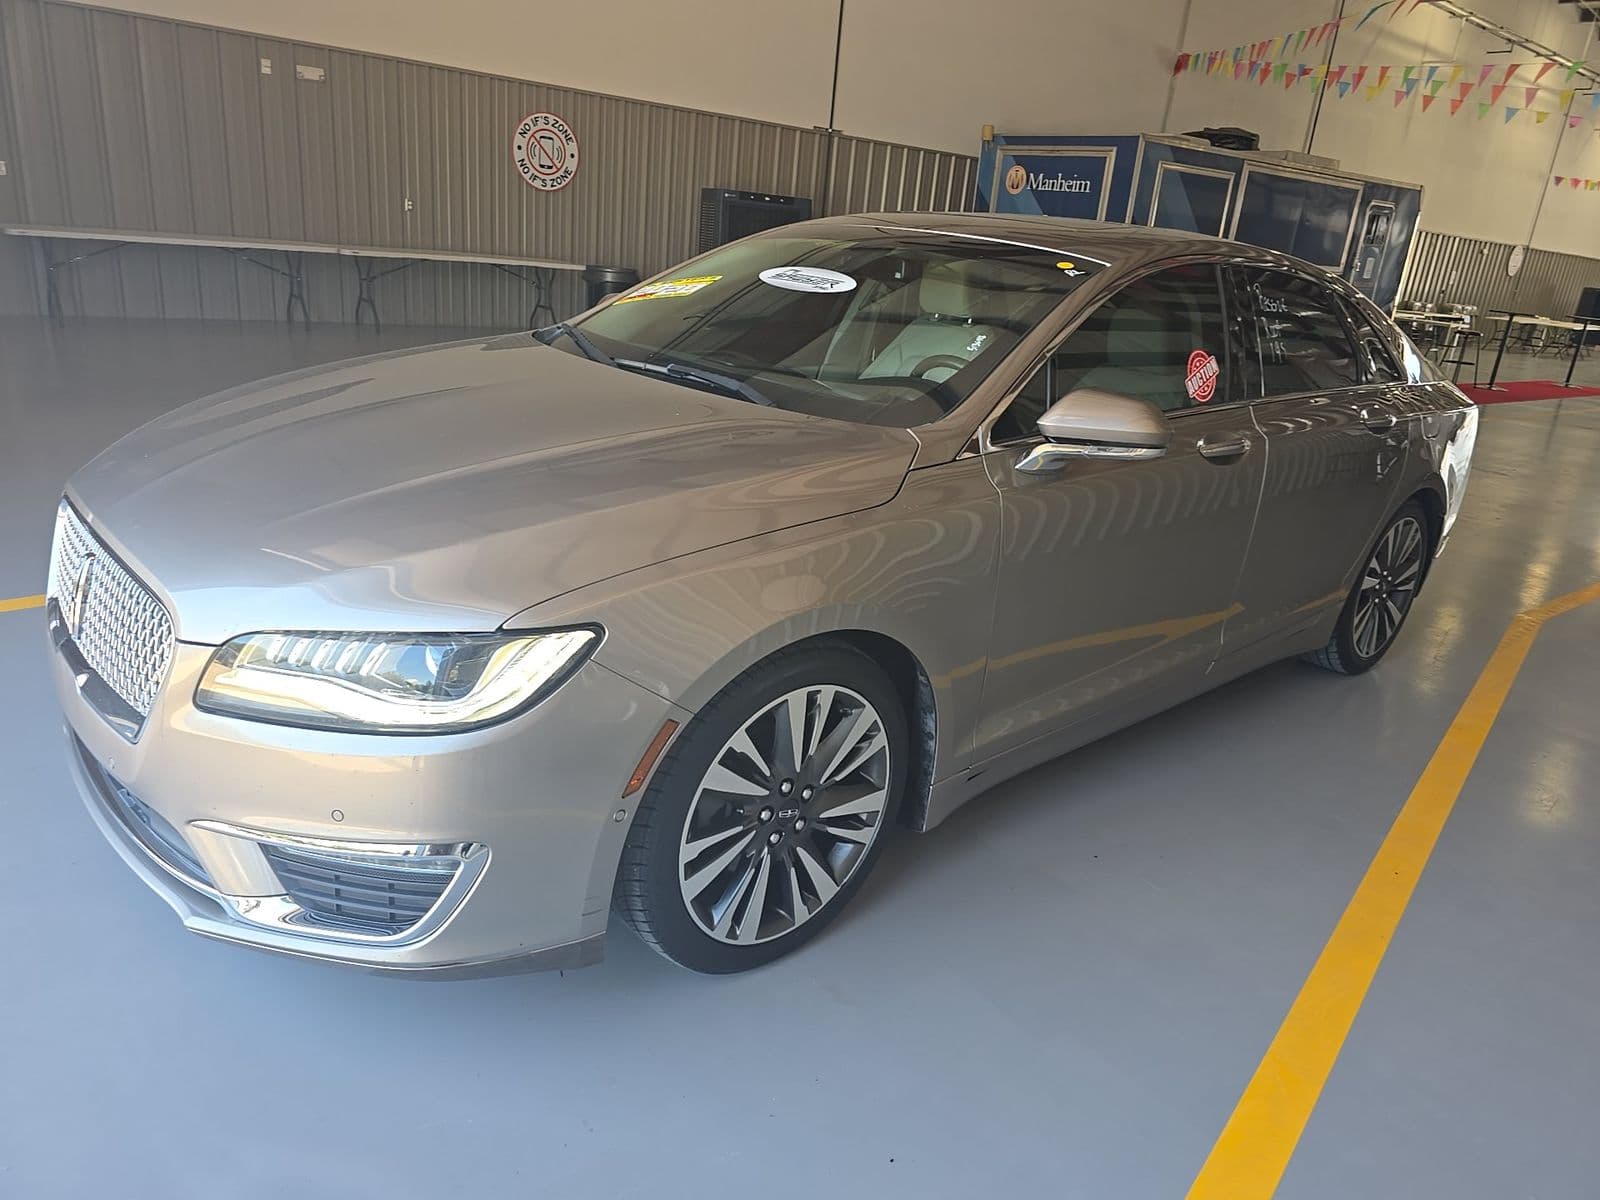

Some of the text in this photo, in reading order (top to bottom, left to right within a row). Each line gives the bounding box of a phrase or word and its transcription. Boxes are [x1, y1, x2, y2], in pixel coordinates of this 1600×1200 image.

[518, 122, 531, 138] NO
[551, 118, 574, 145] ZONE
[517, 158, 530, 174] NO
[550, 166, 573, 188] ZONE
[1027, 172, 1091, 193] Manheim
[1187, 357, 1219, 396] AUCTION
